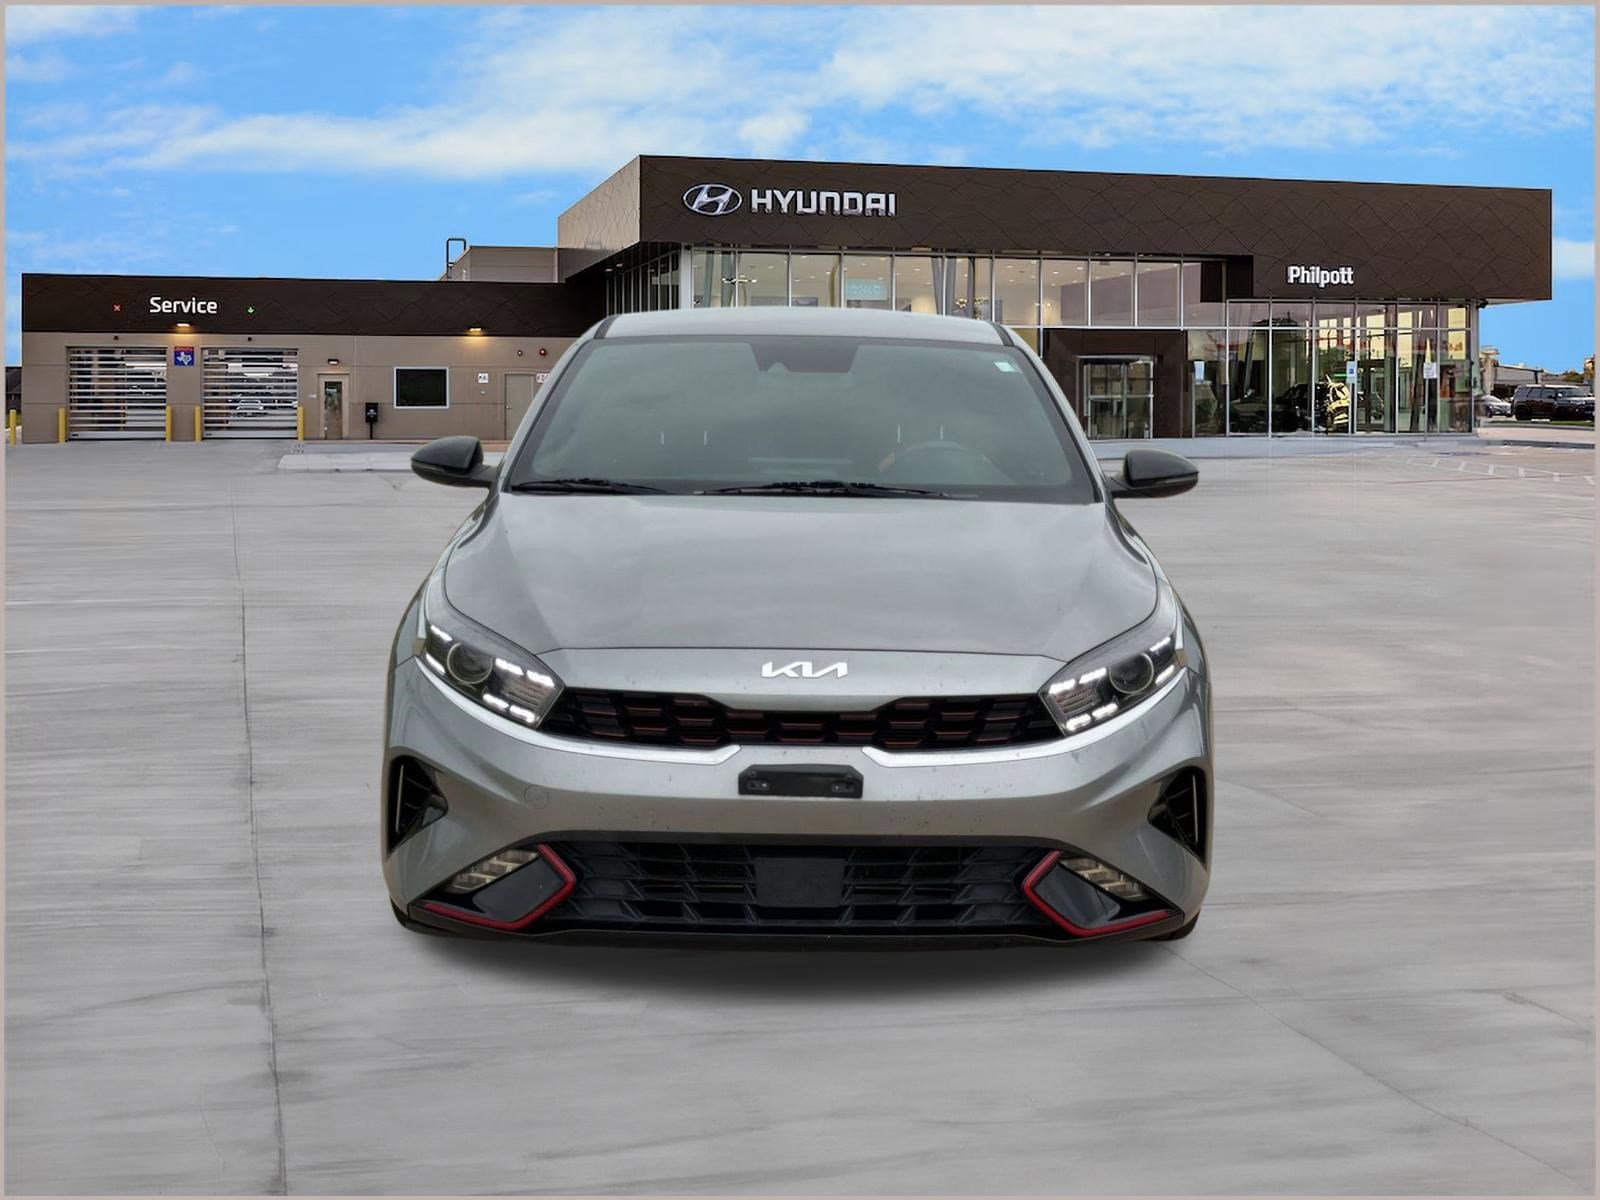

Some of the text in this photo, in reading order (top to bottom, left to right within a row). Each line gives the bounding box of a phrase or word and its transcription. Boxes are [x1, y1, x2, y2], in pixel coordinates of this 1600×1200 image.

[751, 189, 896, 216] HYUNDAI
[1287, 265, 1354, 288] Philpott
[149, 296, 218, 314] Service
